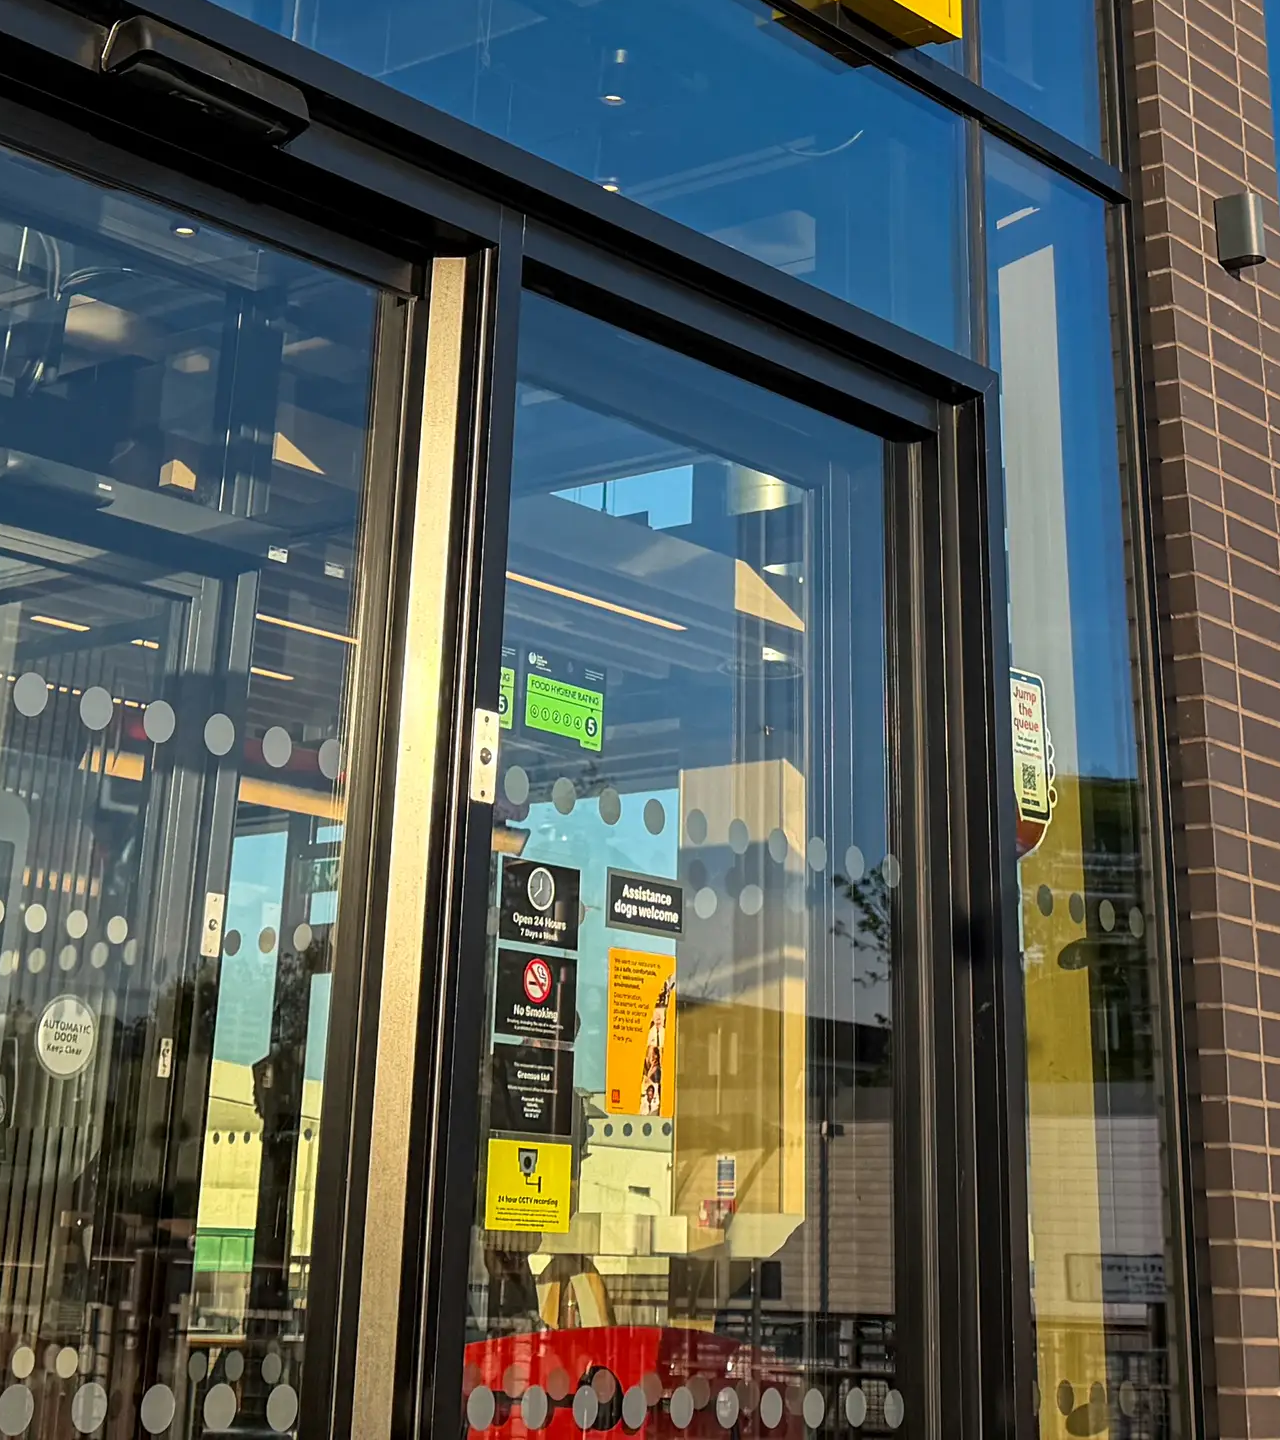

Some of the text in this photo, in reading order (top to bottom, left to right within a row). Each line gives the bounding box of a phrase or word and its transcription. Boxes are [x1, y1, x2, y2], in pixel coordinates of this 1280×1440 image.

[531, 679, 550, 691] FOOD
[1013, 686, 1037, 704] Jump
[1018, 703, 1032, 717] the
[1014, 717, 1040, 732] queue
[622, 884, 672, 905] Assistance
[614, 899, 679, 924] dogs welcome
[512, 911, 566, 930] Open 24 Hours
[524, 929, 538, 940] Days
[513, 1004, 558, 1022] No Smoking
[43, 1019, 91, 1035] AUTOMATIC
[54, 1031, 78, 1043] DOOR
[46, 1043, 82, 1055] Keep Clear
[505, 1195, 517, 1203] hour
[518, 1196, 533, 1204] CCTV
[533, 1197, 558, 1208] recording
